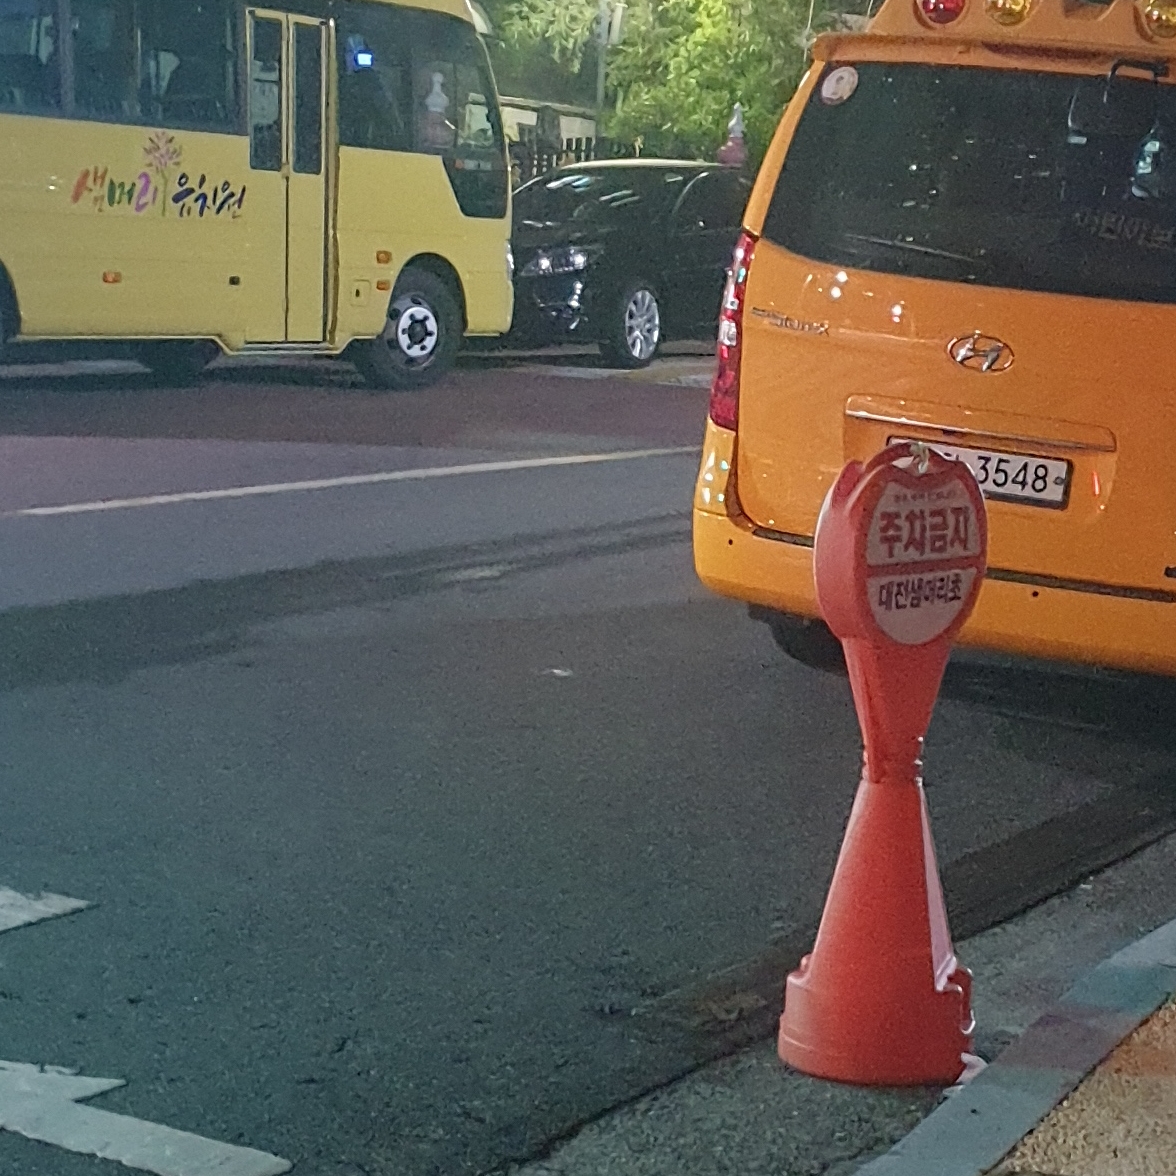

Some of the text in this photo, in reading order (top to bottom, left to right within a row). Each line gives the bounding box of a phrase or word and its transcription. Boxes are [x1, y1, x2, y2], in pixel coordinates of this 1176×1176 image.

[71, 166, 246, 219] 샘머리 유치원
[977, 455, 1049, 493] 3548
[879, 506, 970, 559] 주차금지
